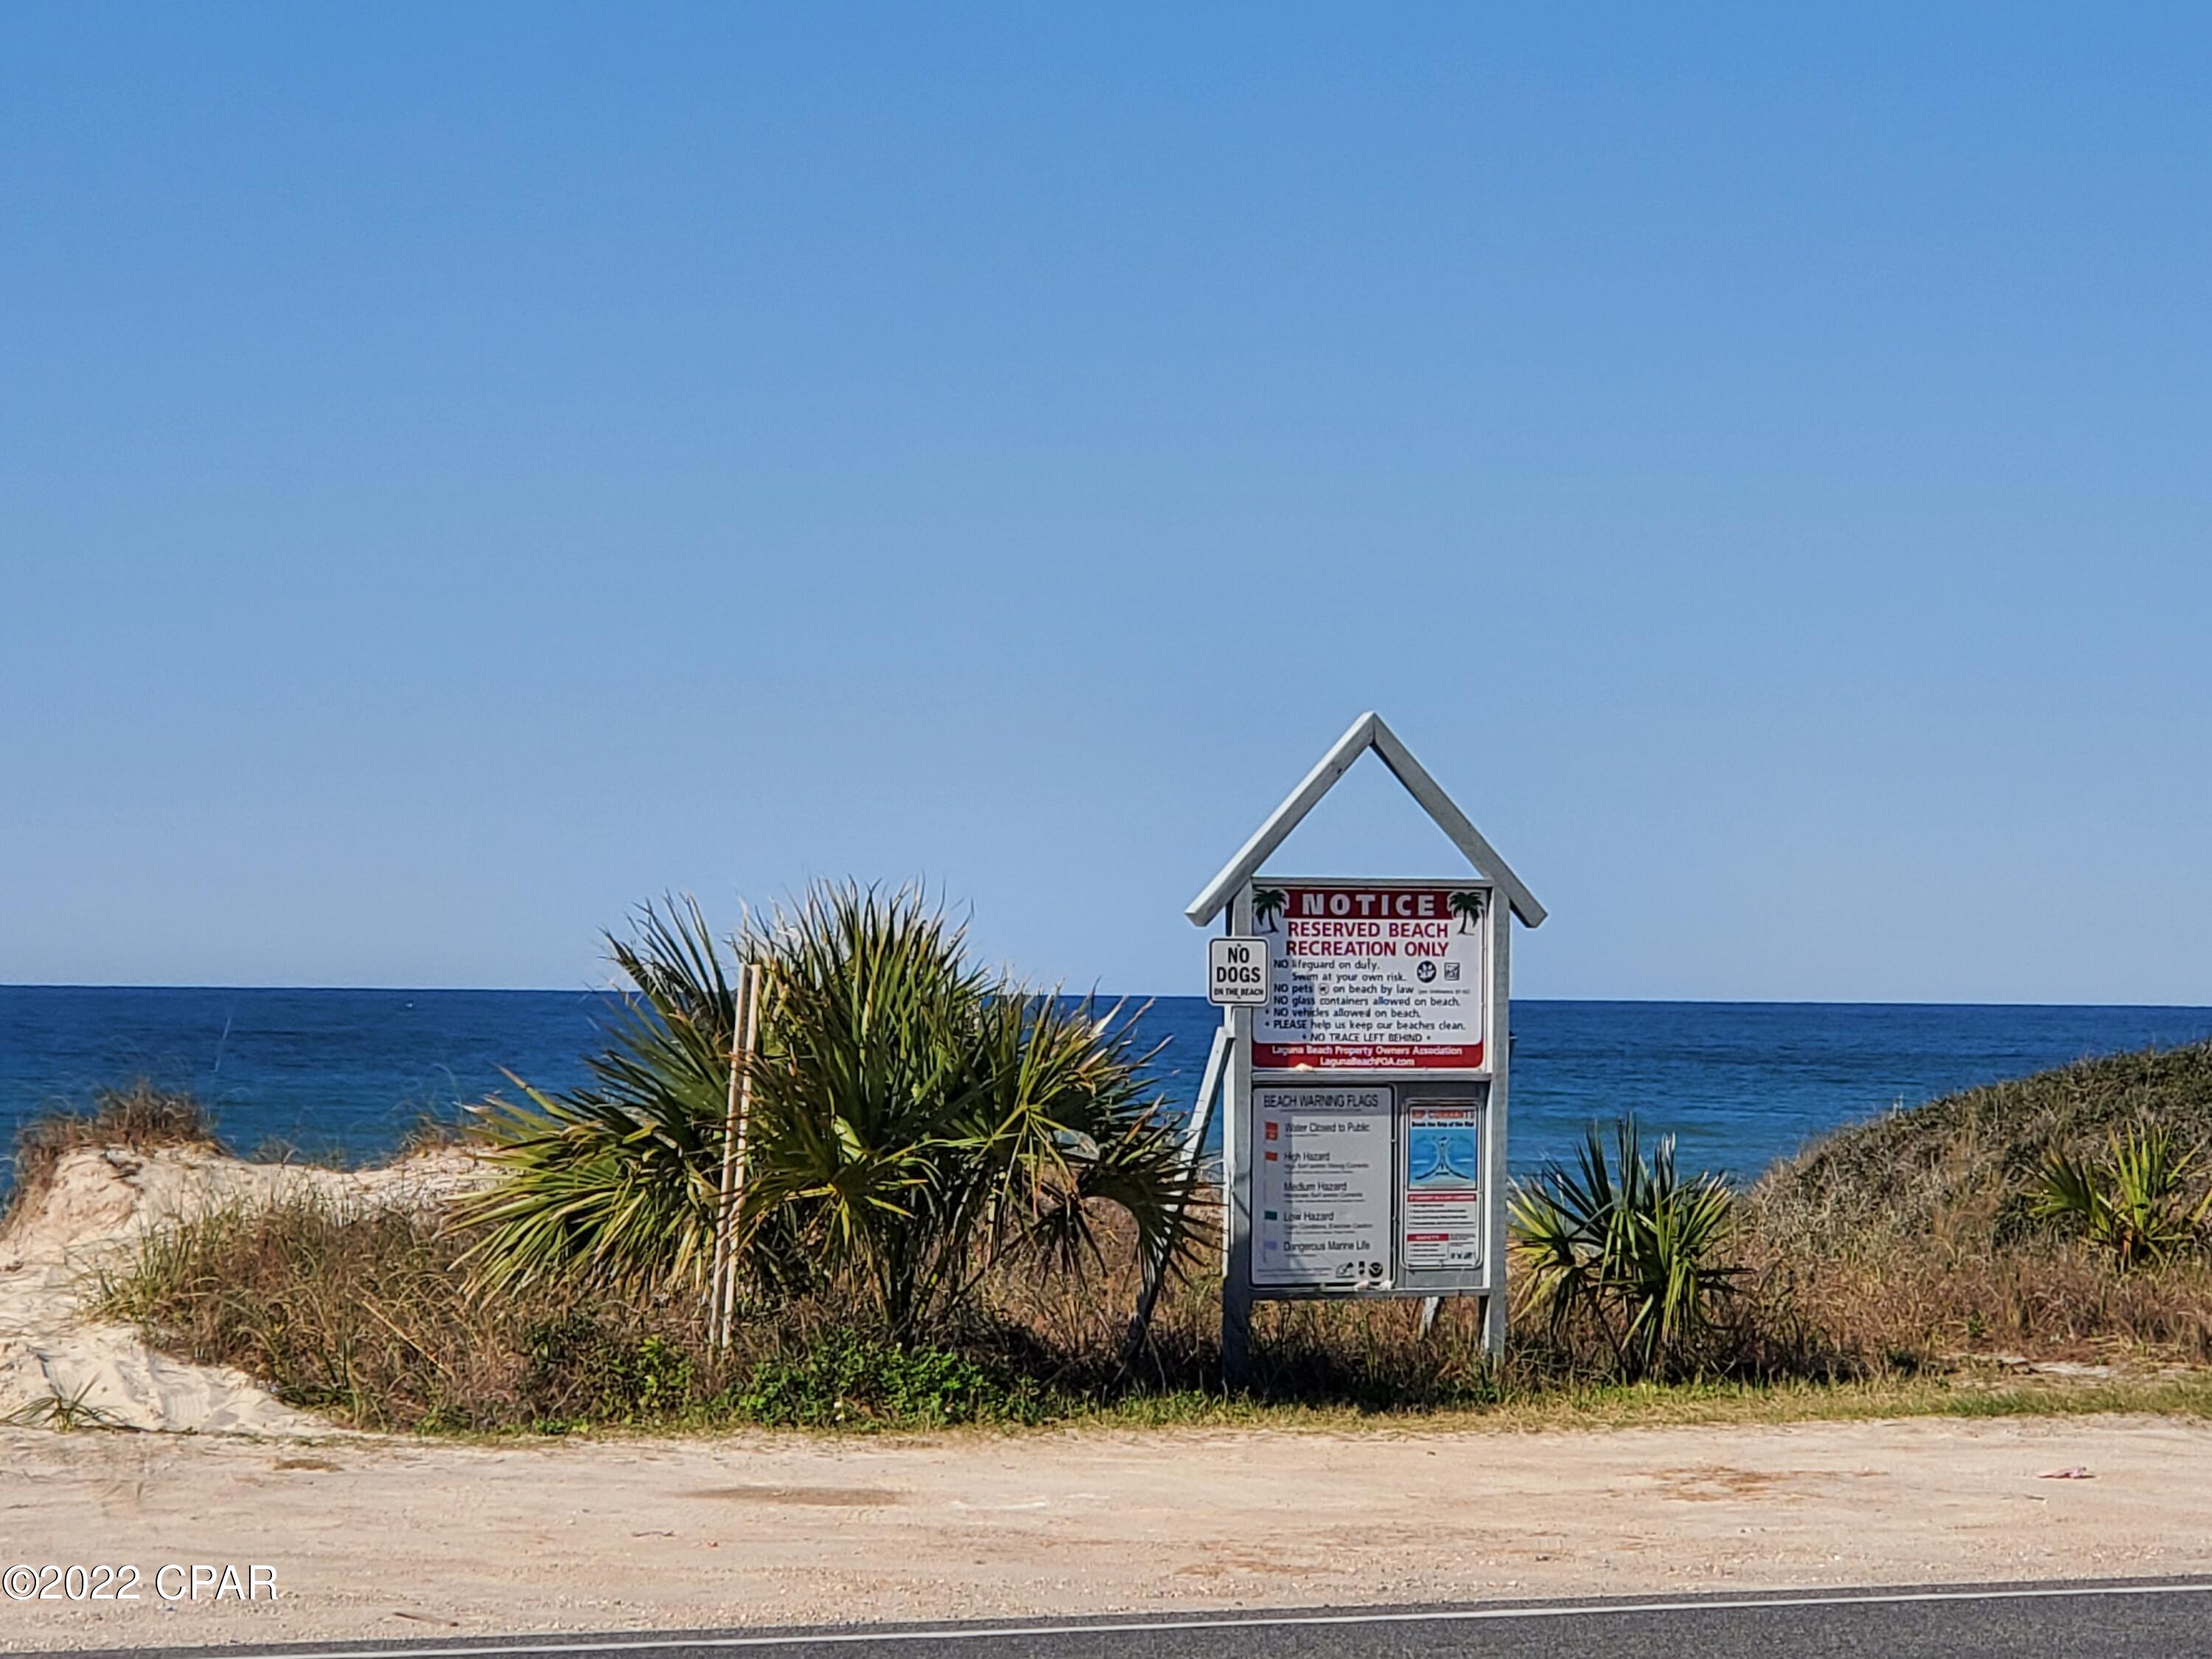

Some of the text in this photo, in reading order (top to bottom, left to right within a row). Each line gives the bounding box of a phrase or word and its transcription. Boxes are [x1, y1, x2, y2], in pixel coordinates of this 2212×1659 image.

[1302, 893, 1436, 916] NOTICE
[1288, 922, 1448, 938] RESERVED BEACH
[1228, 947, 1250, 963] NO
[1286, 942, 1449, 957] RECREATION ONLY
[1273, 960, 1289, 968] NO
[1292, 959, 1335, 971] lifeguard
[1217, 967, 1261, 983] DOGS
[1292, 973, 1318, 981] Swim
[1336, 974, 1357, 983] your
[1240, 988, 1264, 996] BEACH
[1273, 984, 1289, 992] NO
[1292, 984, 1312, 995] pets
[1349, 984, 1377, 994] beach
[1380, 984, 1392, 995] by
[1397, 984, 1413, 994] law
[1273, 995, 1289, 1004] NO
[1292, 995, 1315, 1007] glass
[1320, 996, 1368, 1005] containers
[1373, 996, 1411, 1006] allowed
[1273, 1007, 1289, 1017] NO
[1292, 1007, 1329, 1017] vehicles
[1333, 1008, 1371, 1018] allowed
[1273, 1019, 1307, 1029] PLEASE
[1310, 1019, 1331, 1029] help
[1349, 1020, 1373, 1031] keep
[1377, 1022, 1393, 1030] our
[1397, 1020, 1435, 1030] beaches
[1310, 1033, 1423, 1042] NO TRACE LEFT BEHIND
[1272, 1045, 1462, 1056] Laguna Beach Property Owners Association
[1264, 1094, 1378, 1107] BEACH WARNING FLAGS
[1284, 1122, 1370, 1133] Water Closed to Public
[1284, 1152, 1330, 1162] High Hazard
[1284, 1182, 1347, 1192] Medium Hazard
[1284, 1212, 1334, 1222] Low Hazard
[1284, 1240, 1370, 1253] Dangerous Marine Life
